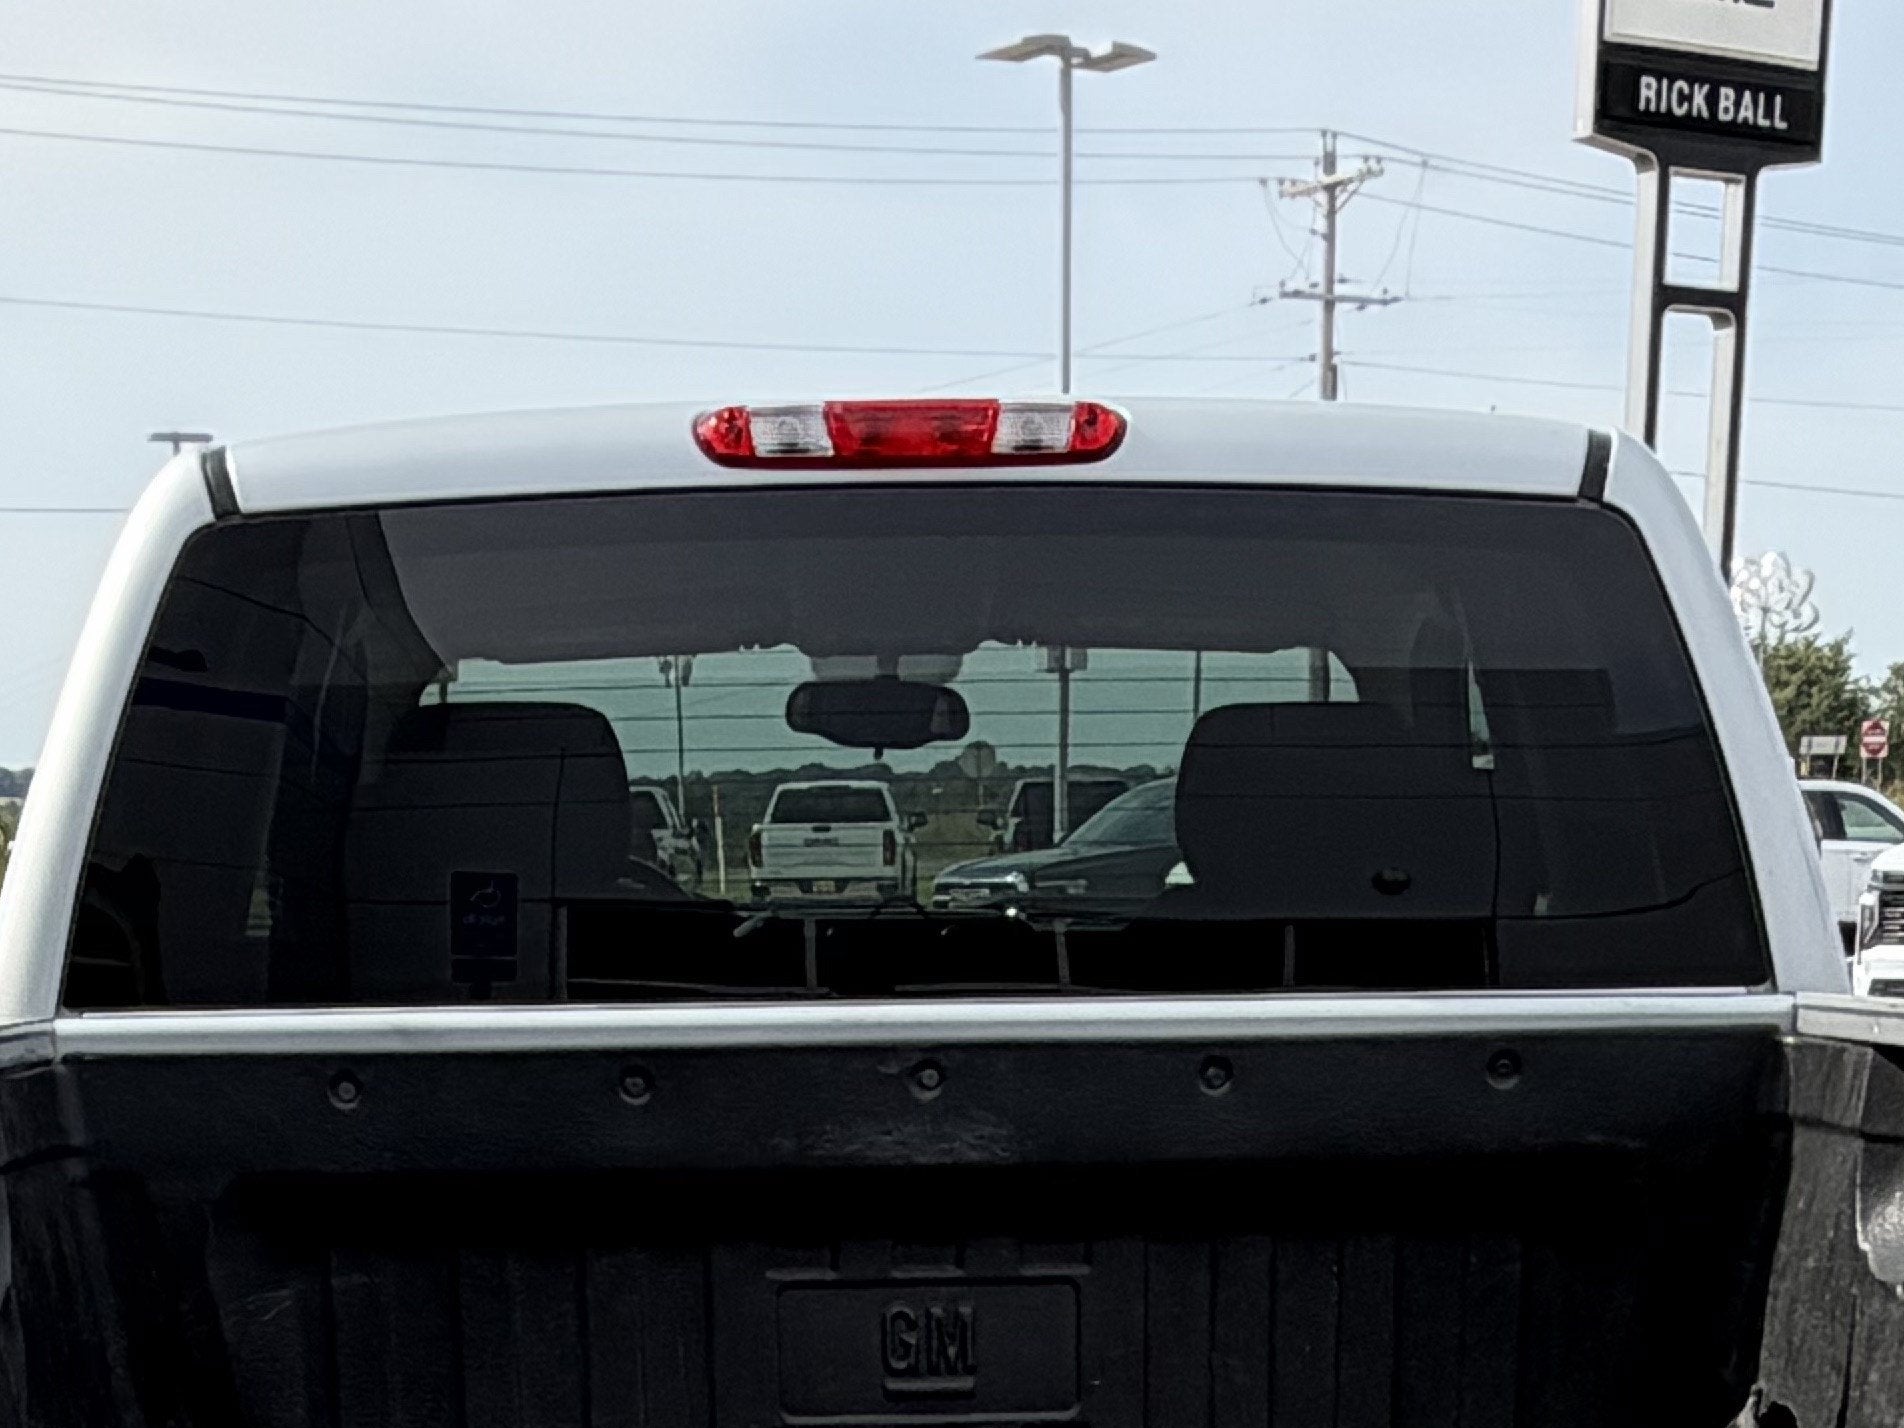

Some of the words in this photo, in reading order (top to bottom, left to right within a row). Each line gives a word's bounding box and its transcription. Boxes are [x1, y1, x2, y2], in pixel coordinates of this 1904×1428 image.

[1638, 75, 1710, 119] RICK
[1717, 86, 1789, 130] BALL
[880, 1302, 977, 1377] GM
